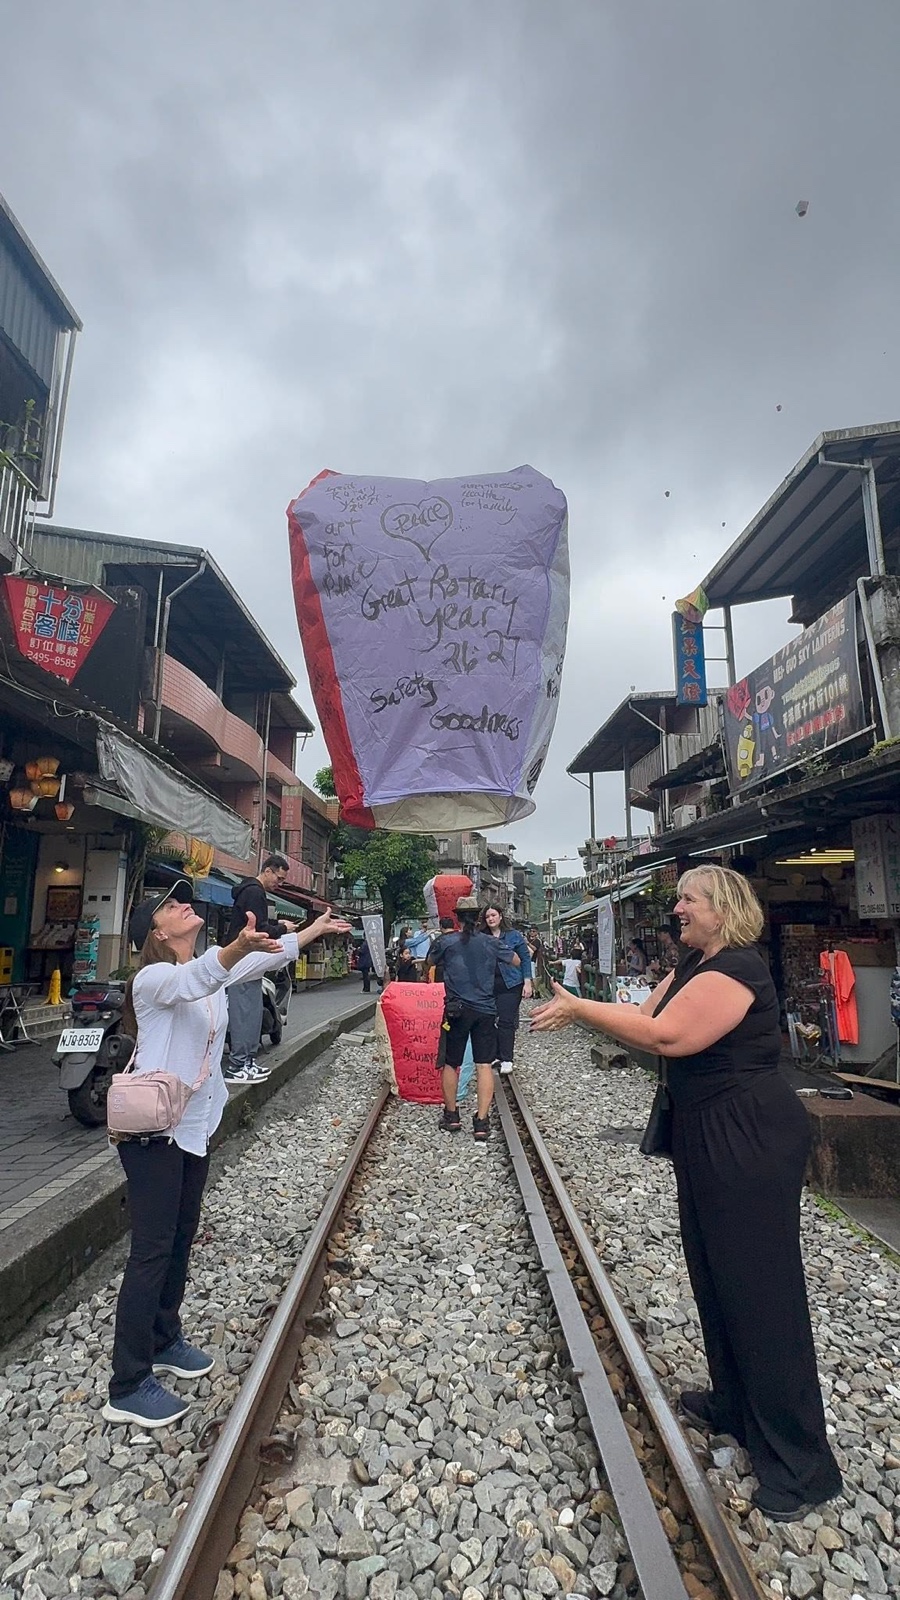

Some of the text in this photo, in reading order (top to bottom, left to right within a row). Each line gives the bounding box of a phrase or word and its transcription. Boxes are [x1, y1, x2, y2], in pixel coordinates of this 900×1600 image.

[39, 588, 84, 620] 十分
[361, 563, 519, 635] Great Rotary
[34, 612, 80, 646] 客棧
[416, 602, 496, 653] year
[27, 650, 77, 669] 2495-8585
[29, 637, 79, 658] 訂位專線
[370, 671, 438, 713] Safety
[416, 1000, 439, 1009] MIND
[59, 1034, 101, 1047] NJQ-8303
